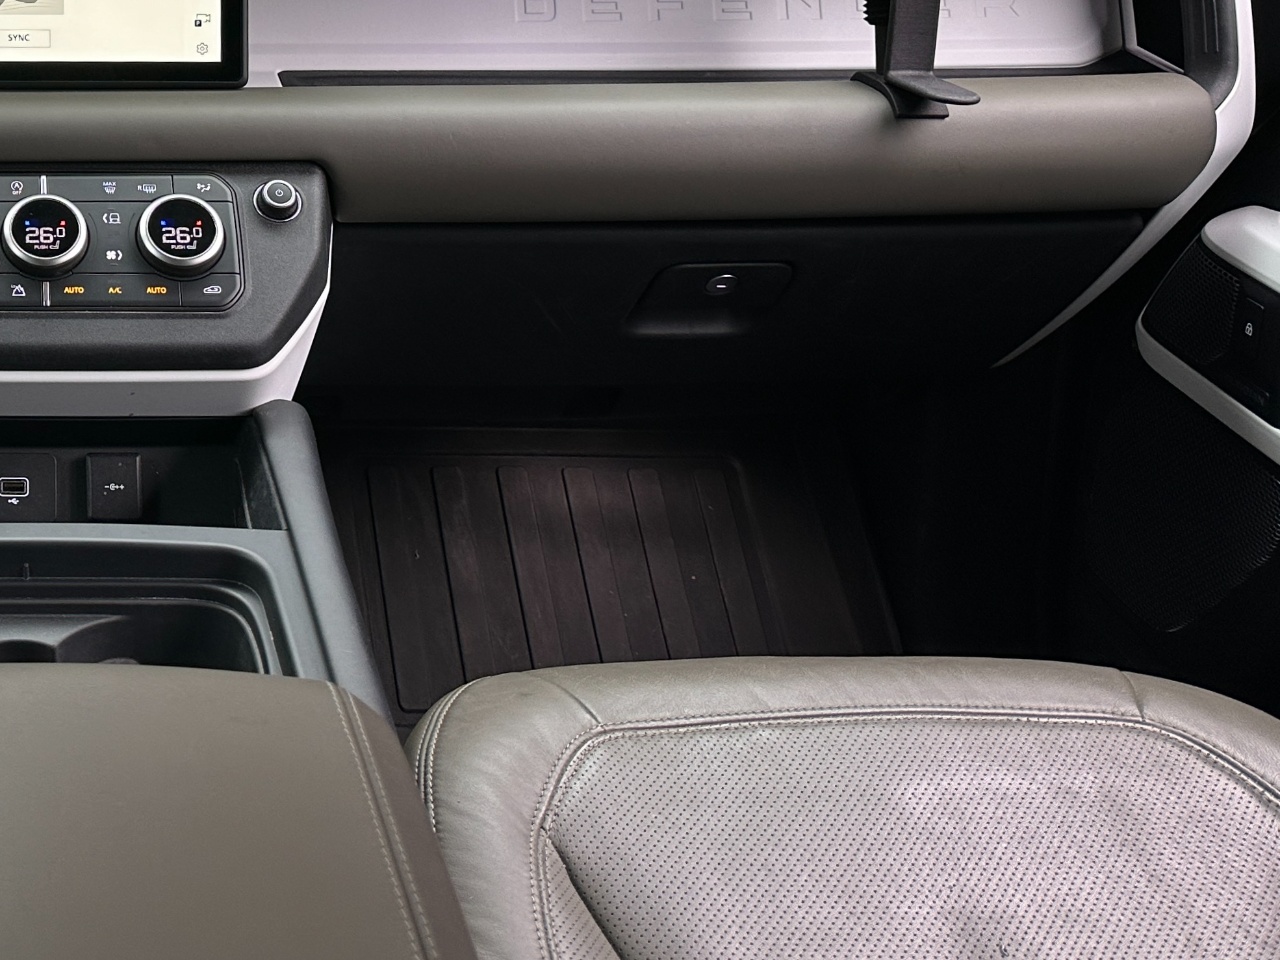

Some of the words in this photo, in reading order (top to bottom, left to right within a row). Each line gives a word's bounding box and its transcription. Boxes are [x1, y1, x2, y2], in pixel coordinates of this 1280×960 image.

[7, 33, 30, 42] SYNC
[25, 226, 66, 244] 26.0
[161, 226, 202, 244] 26.0
[63, 286, 85, 294] AUTO
[108, 286, 122, 294] A/C
[146, 286, 167, 294] AUTO
